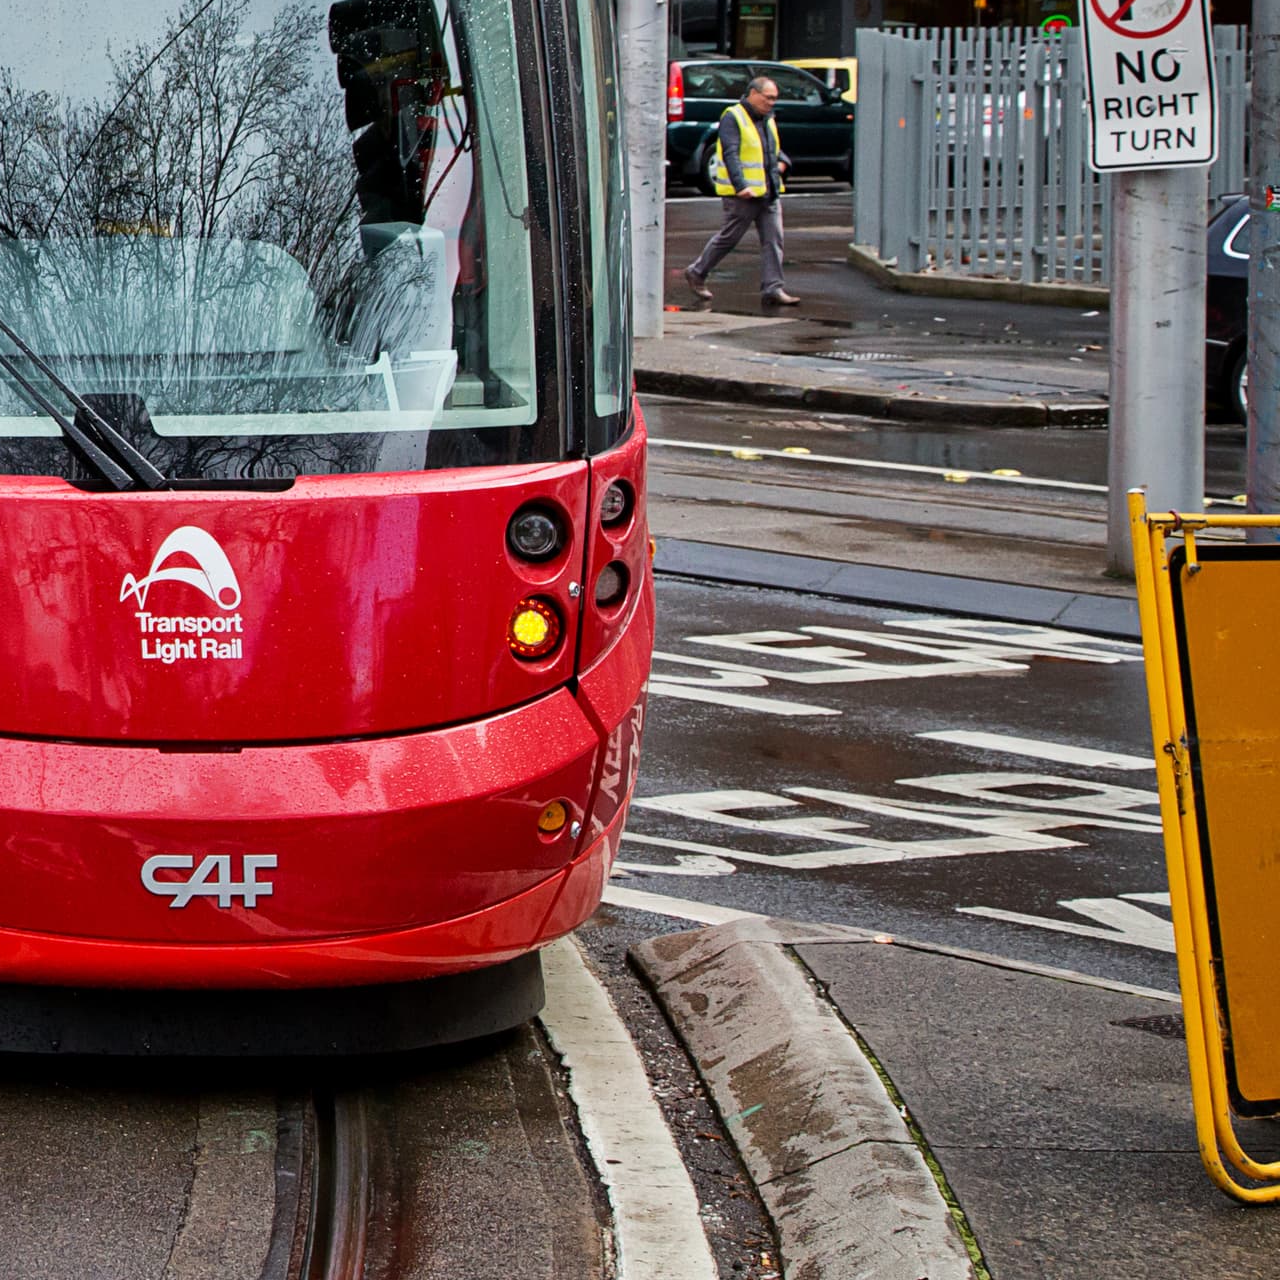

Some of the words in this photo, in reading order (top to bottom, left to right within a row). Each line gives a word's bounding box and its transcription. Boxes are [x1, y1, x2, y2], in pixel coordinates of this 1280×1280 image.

[1116, 48, 1181, 85] NO
[1104, 92, 1199, 119] RIGHT
[1110, 126, 1195, 152] TURN
[135, 612, 243, 637] Transport
[142, 639, 196, 664] Light
[201, 639, 243, 659] Rail
[141, 855, 278, 908] CAF
